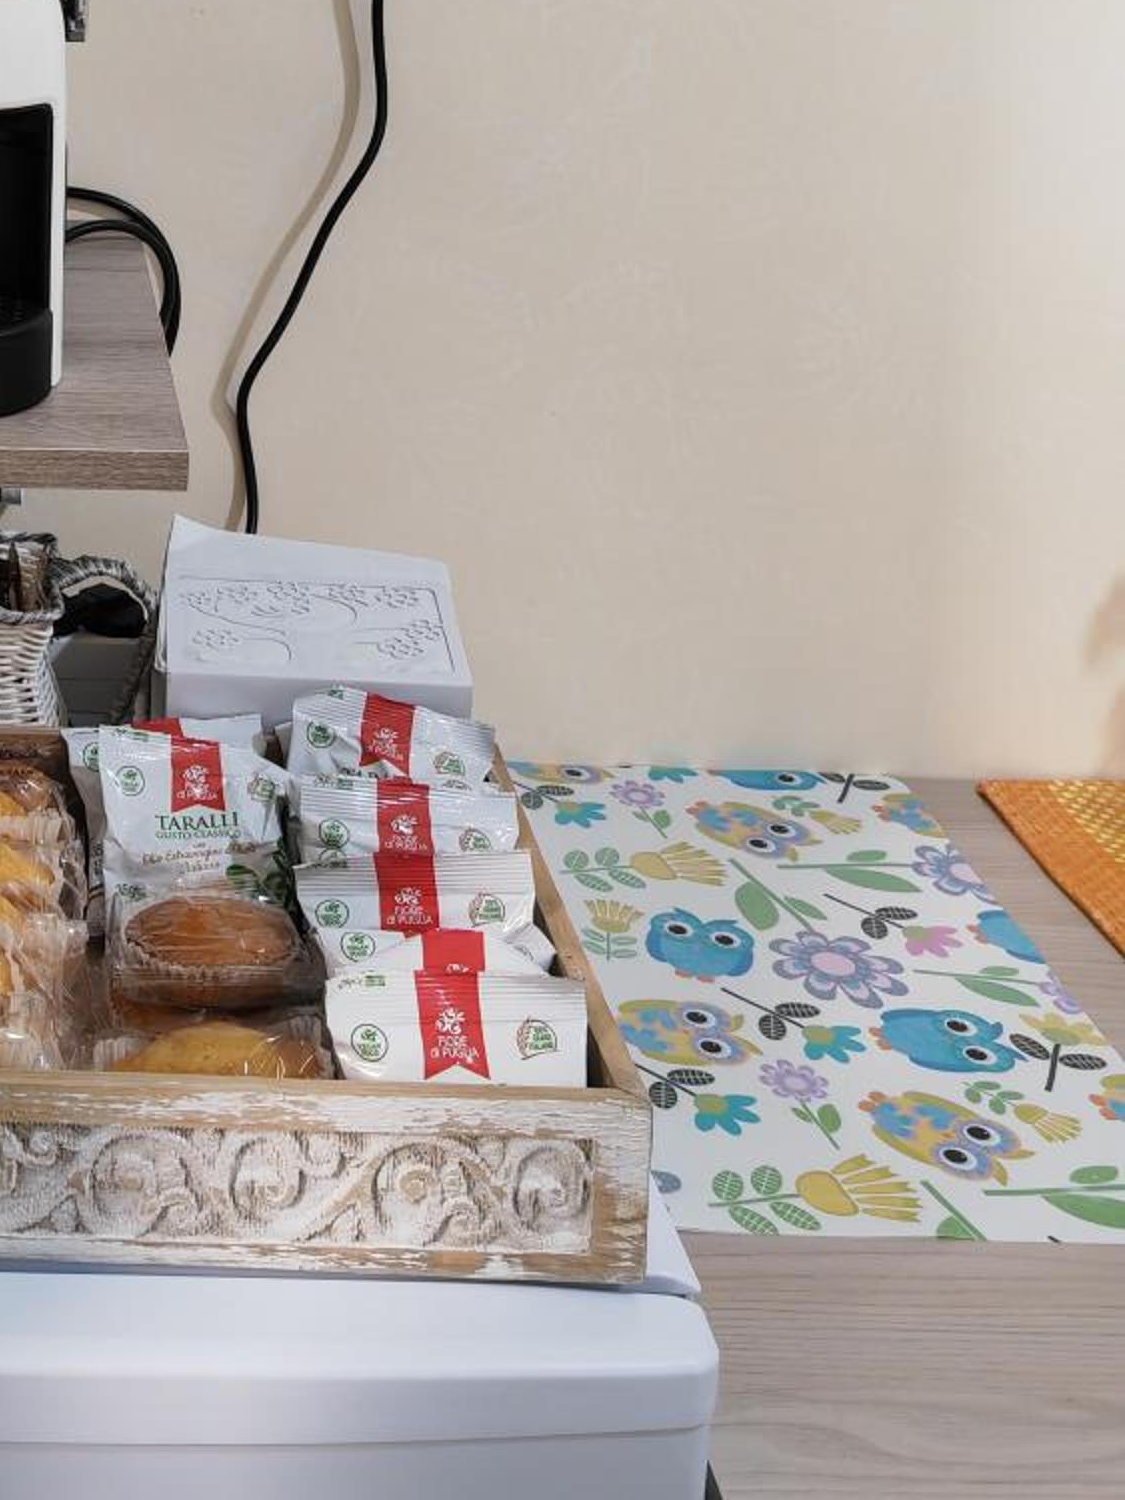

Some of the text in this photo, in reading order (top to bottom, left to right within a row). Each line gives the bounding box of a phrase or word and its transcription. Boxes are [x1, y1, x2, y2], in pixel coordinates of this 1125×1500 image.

[156, 812, 239, 831] TARALLI
[156, 829, 242, 840] GUSTO CLASSICO
[397, 915, 436, 925] PUGLIA
[437, 1034, 469, 1048] FIORE
[442, 1047, 480, 1060] PUGLIA
